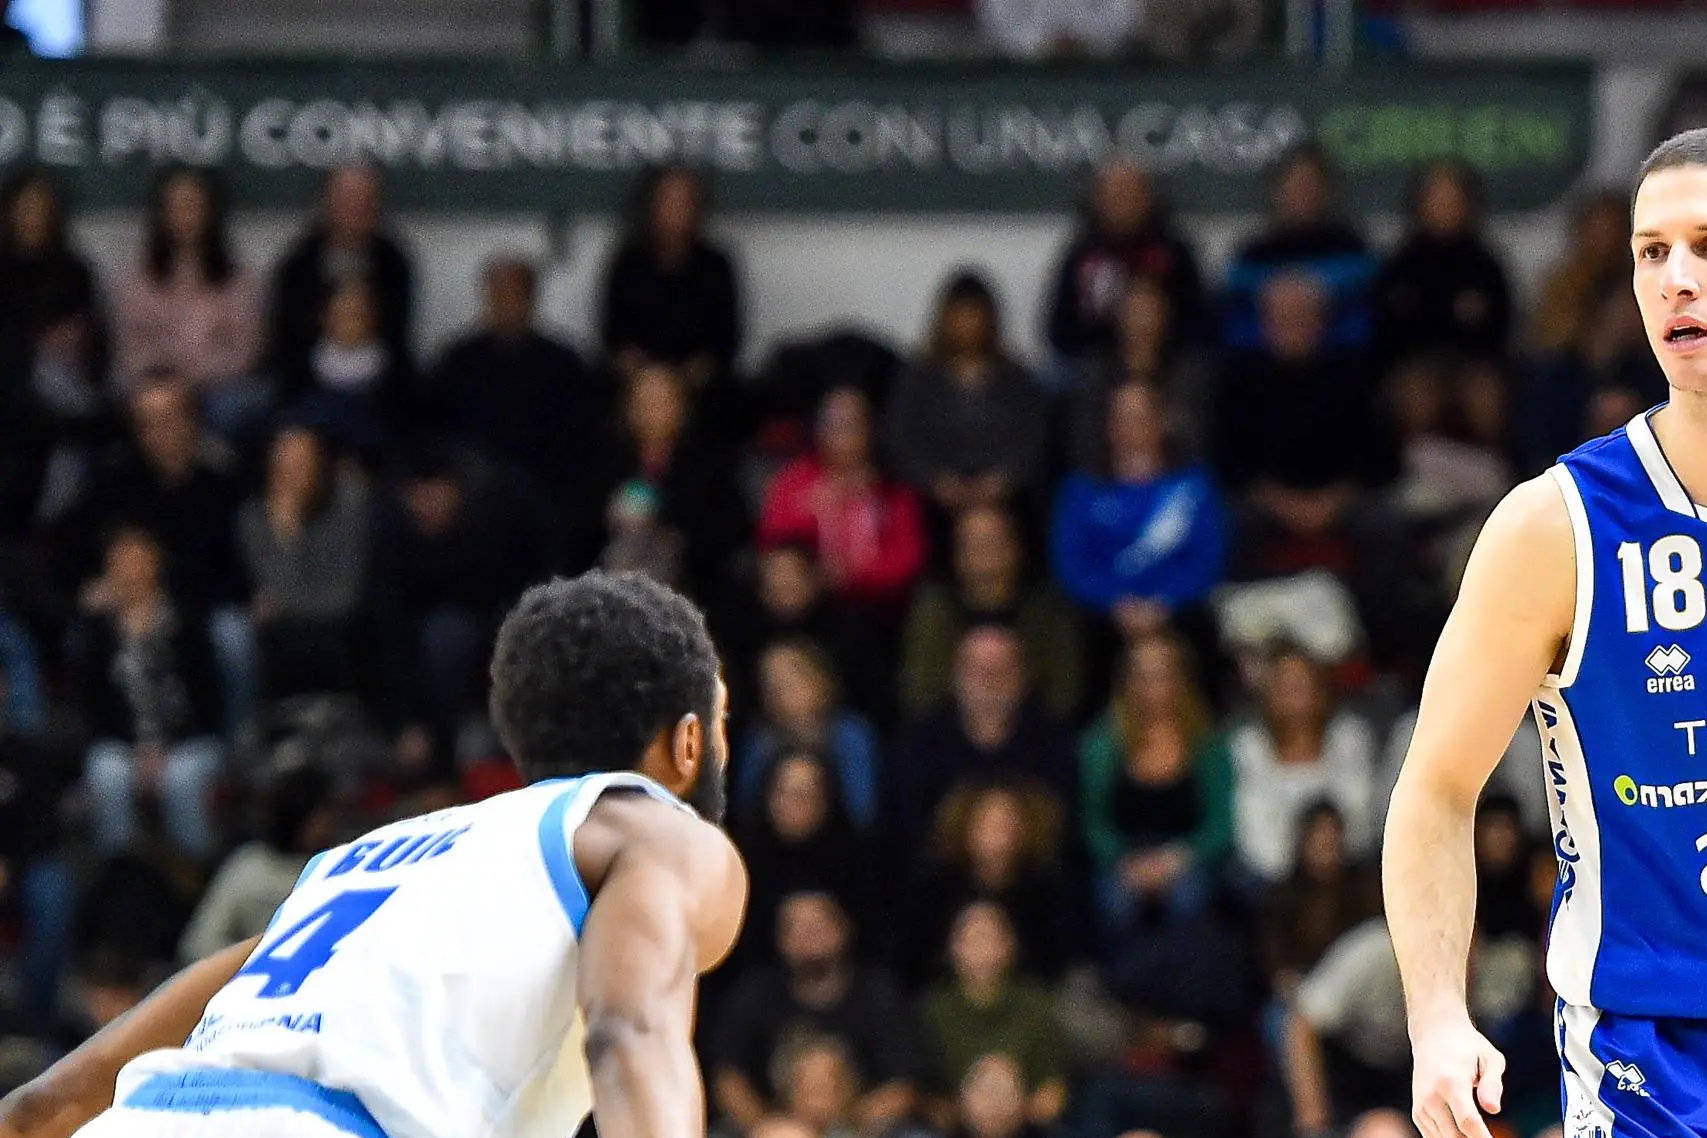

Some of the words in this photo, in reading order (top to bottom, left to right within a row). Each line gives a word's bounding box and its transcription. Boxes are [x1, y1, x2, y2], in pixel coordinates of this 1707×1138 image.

[240, 98, 764, 169] CONVENIENTE
[770, 98, 938, 172] CON
[1617, 534, 1706, 633] 18
[1646, 674, 1695, 693] errea
[235, 885, 399, 999] 4
